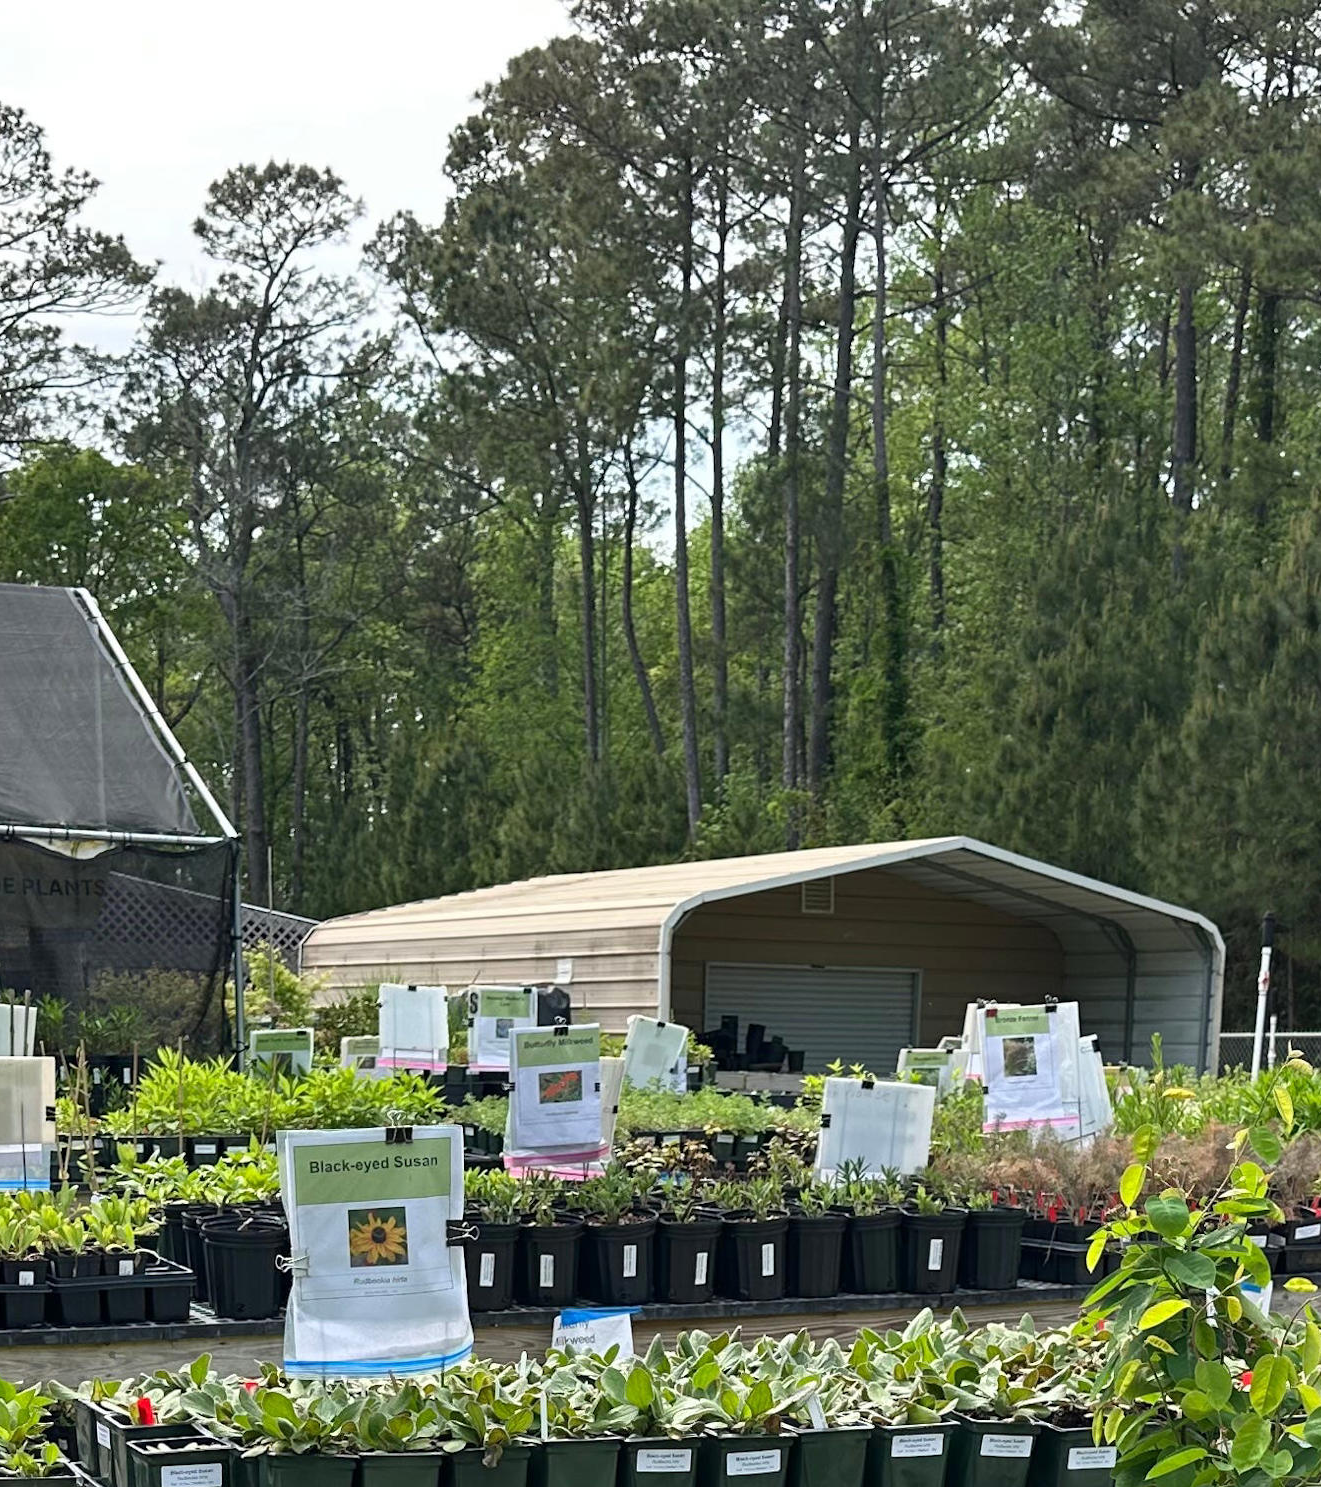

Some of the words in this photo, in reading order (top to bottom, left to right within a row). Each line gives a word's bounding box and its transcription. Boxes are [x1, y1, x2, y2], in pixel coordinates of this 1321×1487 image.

[22, 878, 106, 897] PLANTS
[309, 1157, 389, 1174] Black-eyed
[393, 1155, 438, 1169] Susan
